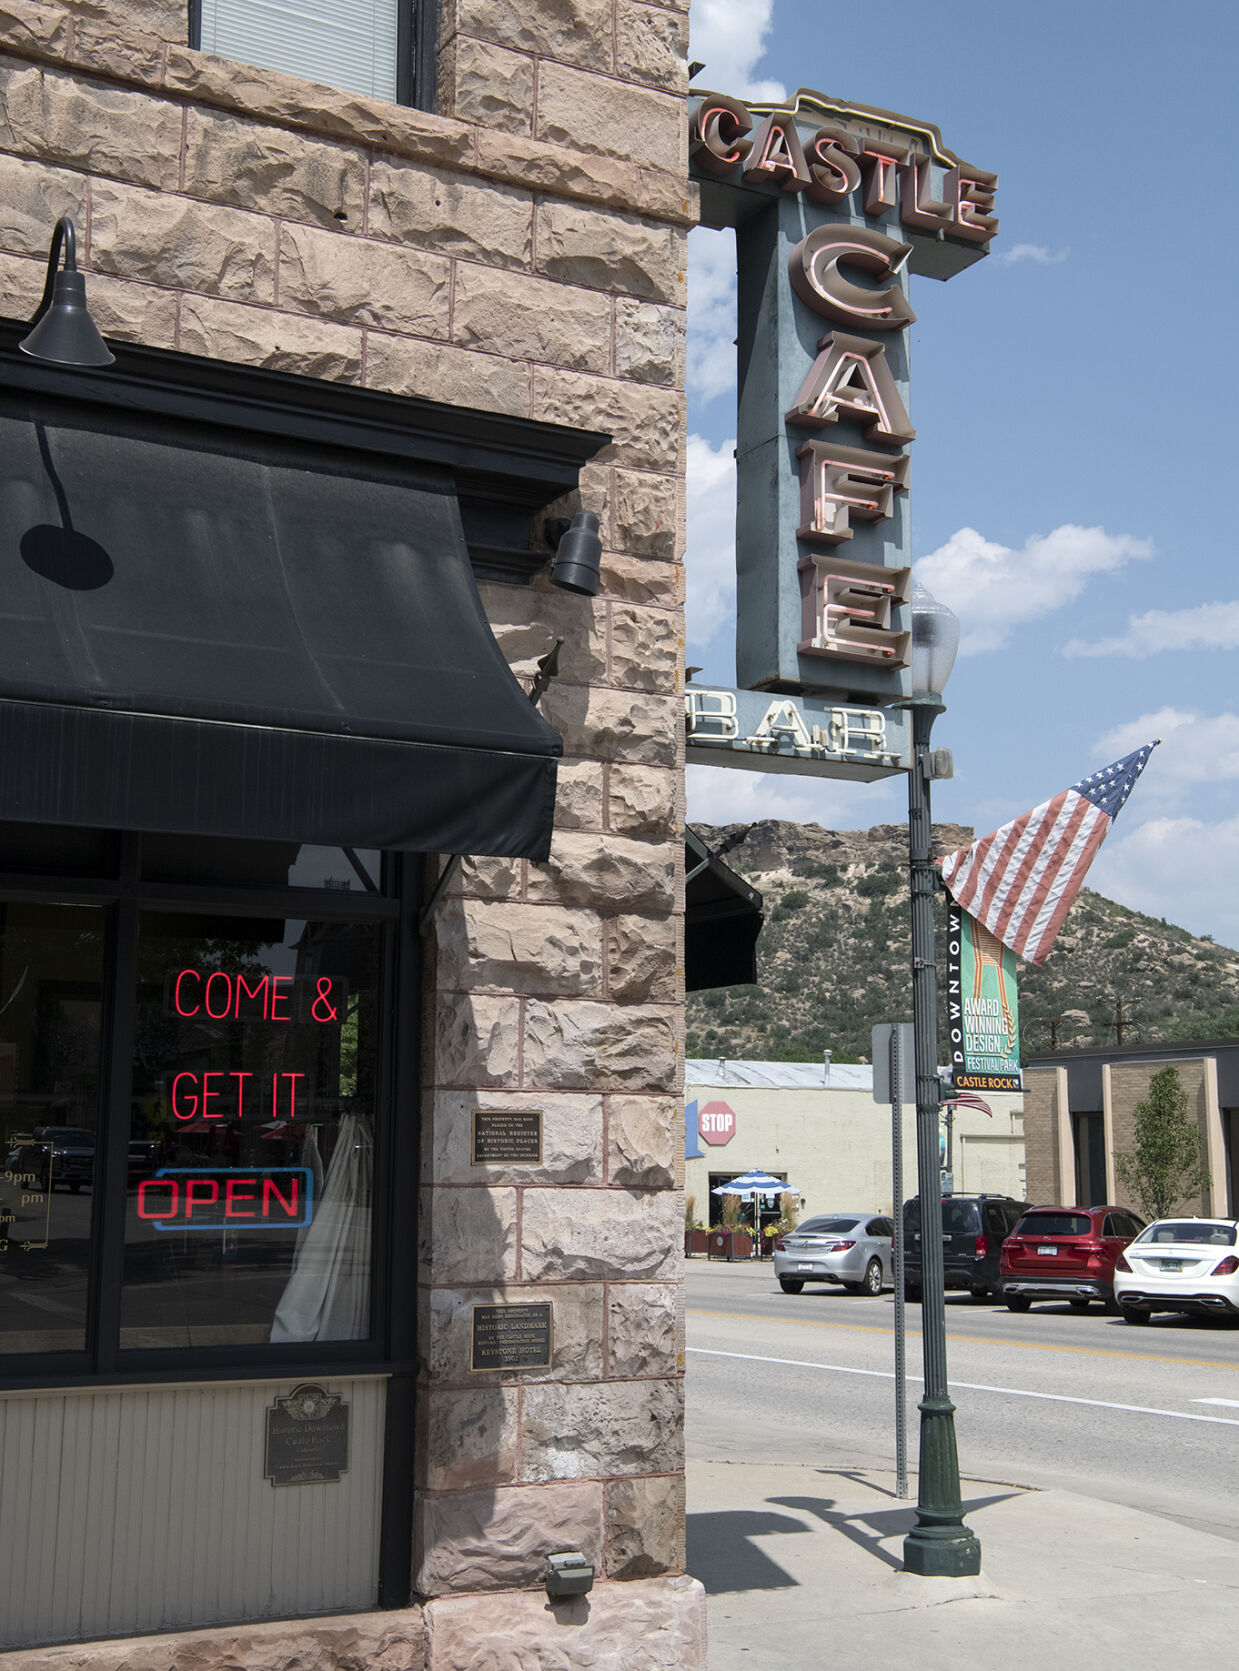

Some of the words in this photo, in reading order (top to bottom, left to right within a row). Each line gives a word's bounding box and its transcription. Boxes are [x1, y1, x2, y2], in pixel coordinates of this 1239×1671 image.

[690, 94, 999, 243] CASTLE
[786, 223, 917, 673] CAFE
[685, 690, 902, 759] BAR
[175, 969, 293, 1021] COME
[311, 976, 338, 1022] &
[963, 998, 999, 1016] AWARD
[964, 1015, 1009, 1036] WINNING
[965, 1033, 1001, 1053] DESIGN
[967, 1057, 998, 1071] FESTIVAL
[999, 1059, 1018, 1073] PARK
[957, 1075, 987, 1088] CASTLE
[988, 1077, 1013, 1089] ROCK
[172, 1072, 253, 1120] GET
[272, 1073, 305, 1118] IT
[702, 1113, 733, 1132] STOP
[137, 1179, 298, 1219] OPEN
[476, 1323, 508, 1331] HISTORIC
[511, 1321, 547, 1330] LANDMARK
[481, 1347, 517, 1355] KEYSTONE
[519, 1346, 541, 1354] HOTEL
